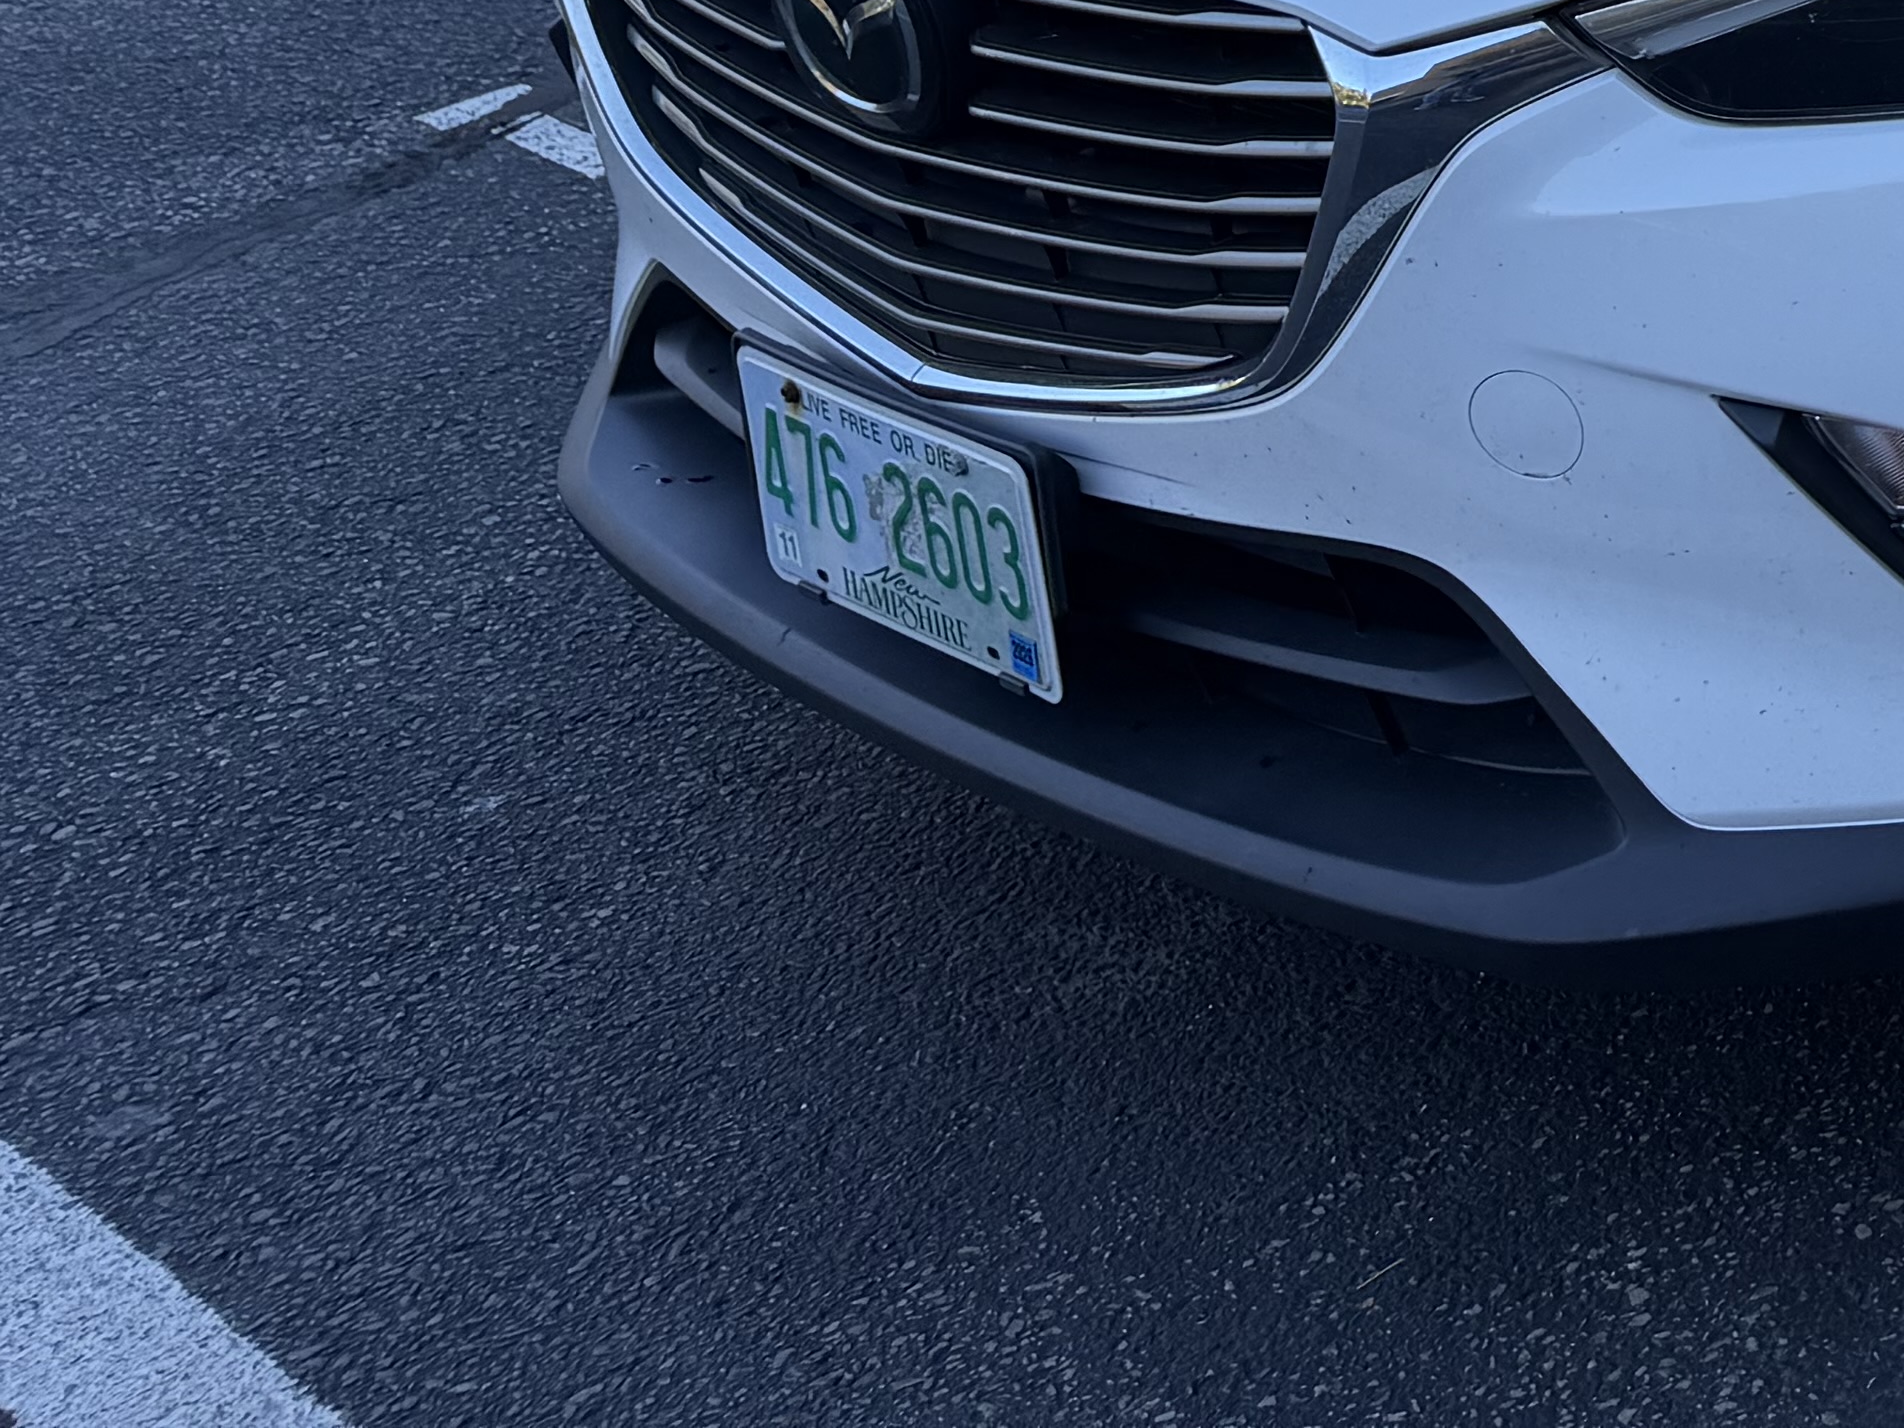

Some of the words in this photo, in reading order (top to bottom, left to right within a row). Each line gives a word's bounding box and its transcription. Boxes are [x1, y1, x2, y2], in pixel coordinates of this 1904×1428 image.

[800, 392, 832, 423] LIVE
[839, 408, 883, 445] FREE
[890, 430, 921, 462] OR
[924, 443, 954, 472] DIE
[765, 406, 858, 544] 476
[882, 461, 1029, 621] 2603
[778, 530, 798, 560] 11
[843, 566, 972, 652] HAMPSHIRE
[864, 565, 941, 606] New
